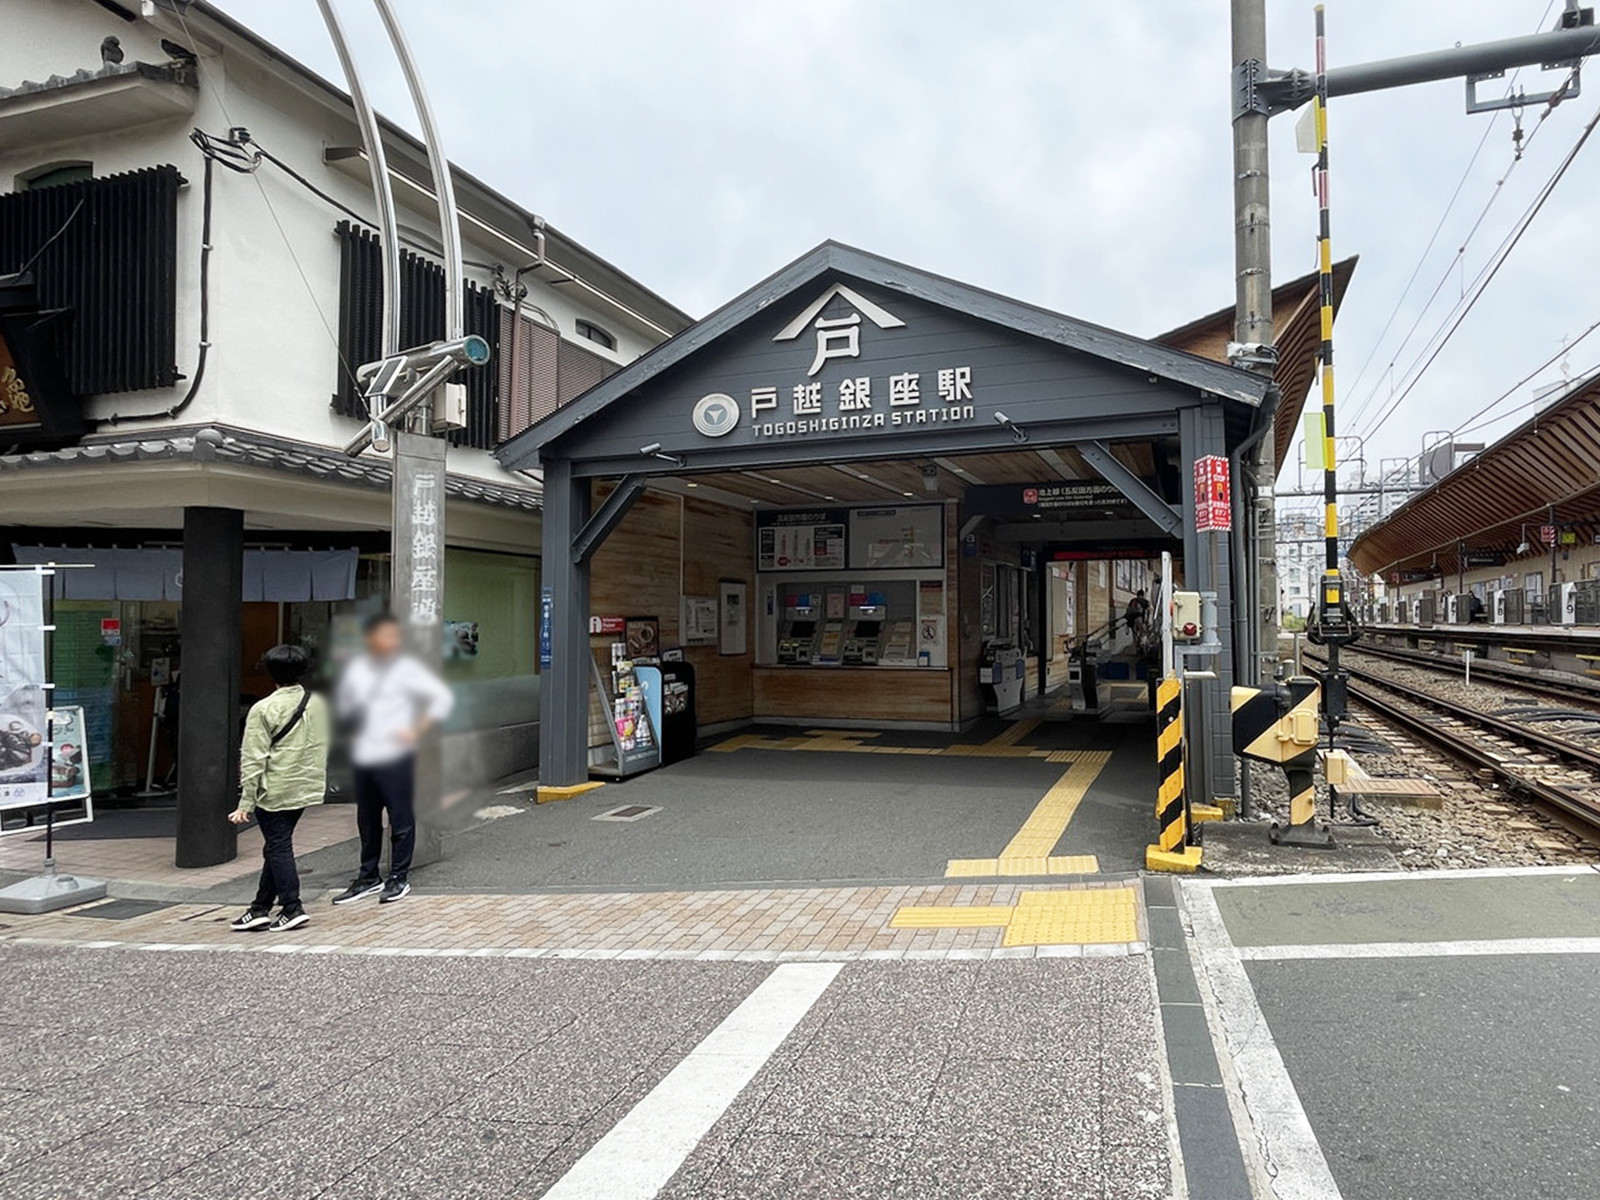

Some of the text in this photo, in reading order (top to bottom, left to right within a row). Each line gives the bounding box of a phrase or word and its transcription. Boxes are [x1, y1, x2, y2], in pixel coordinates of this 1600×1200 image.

[751, 366, 974, 419] 戸越銀座駅
[752, 405, 975, 438] TOGOSHIGINZA STATION
[1566, 604, 1574, 615] 9
